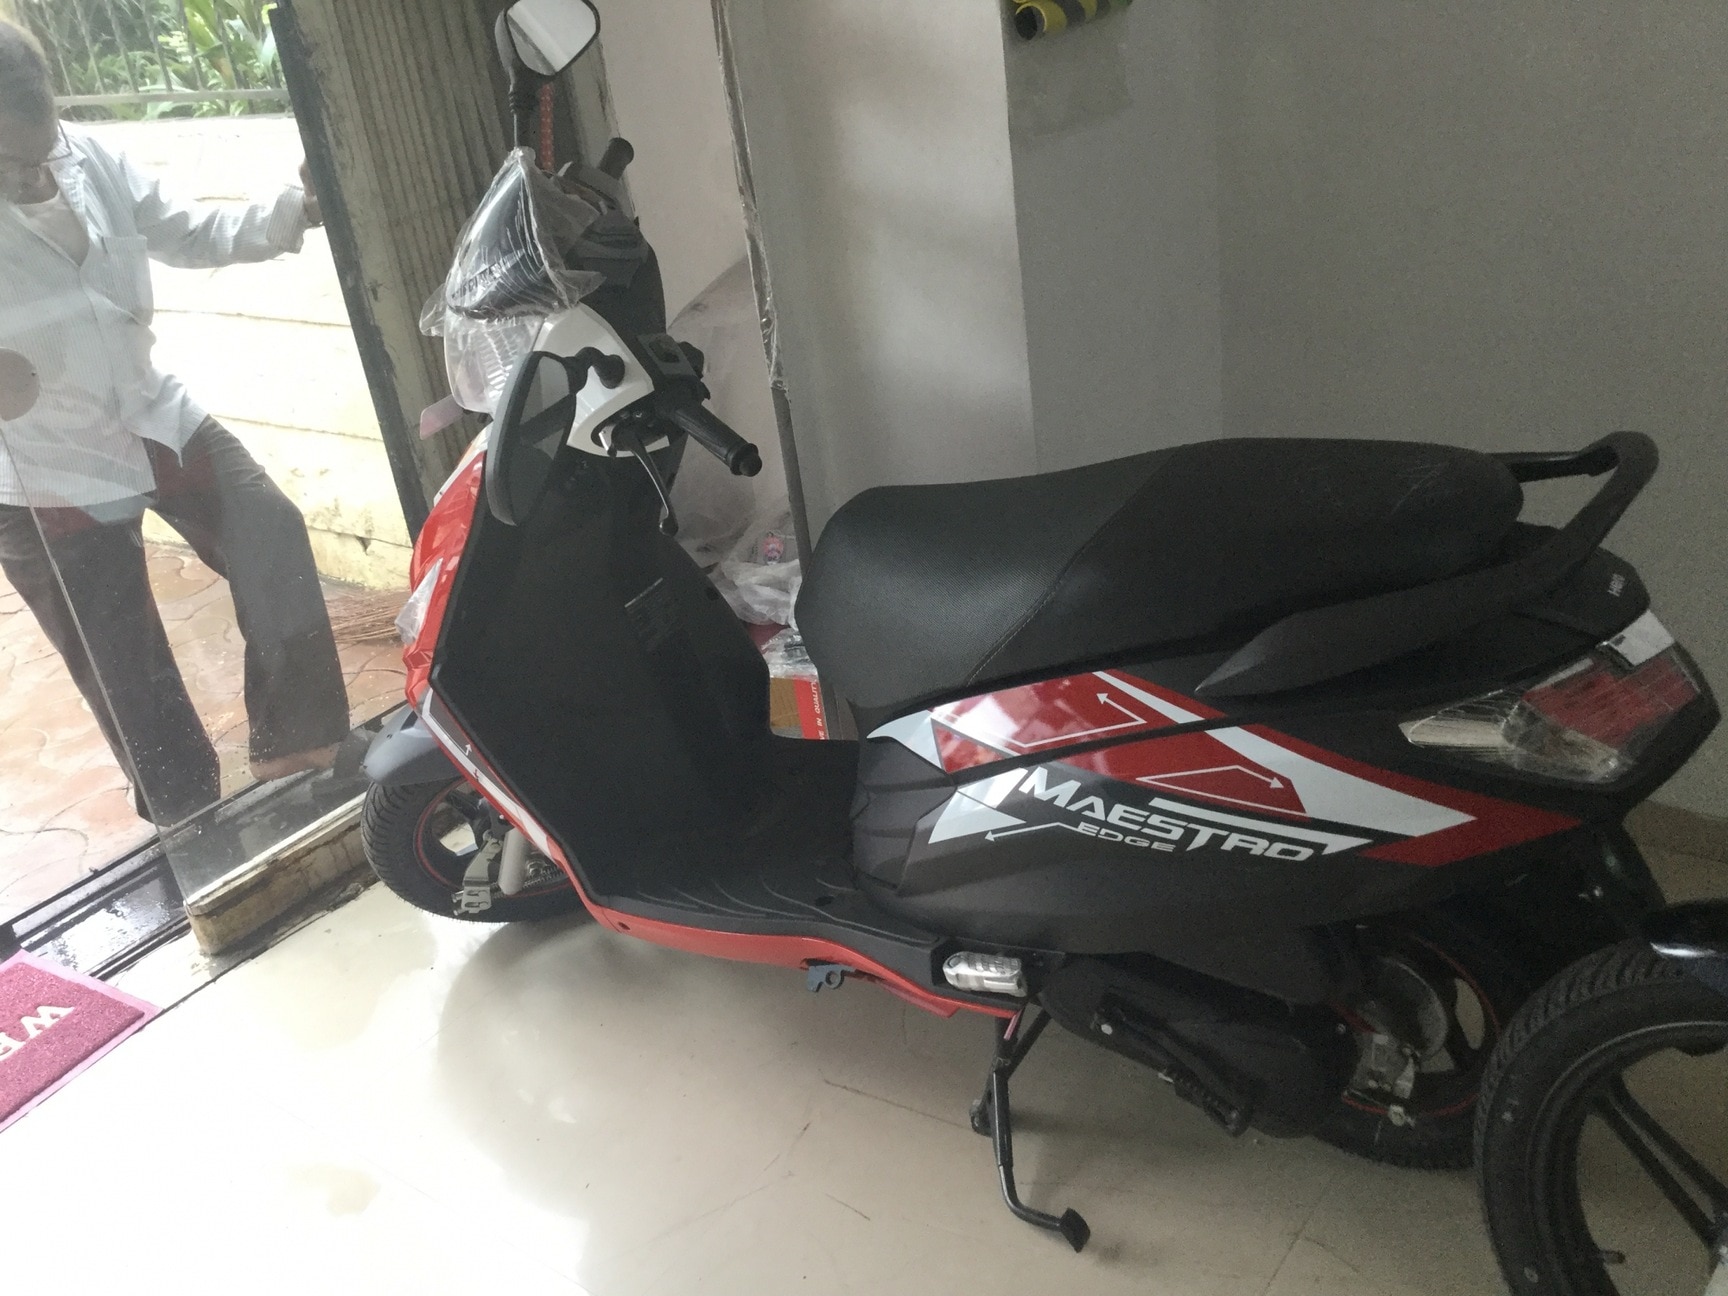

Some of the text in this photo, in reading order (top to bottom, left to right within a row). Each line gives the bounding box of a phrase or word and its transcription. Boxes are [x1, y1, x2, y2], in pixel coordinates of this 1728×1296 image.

[811, 679, 821, 714] QUALITY
[816, 717, 823, 727] IN
[1018, 766, 1314, 862] MAESTRO
[1076, 822, 1177, 852] EDGE
